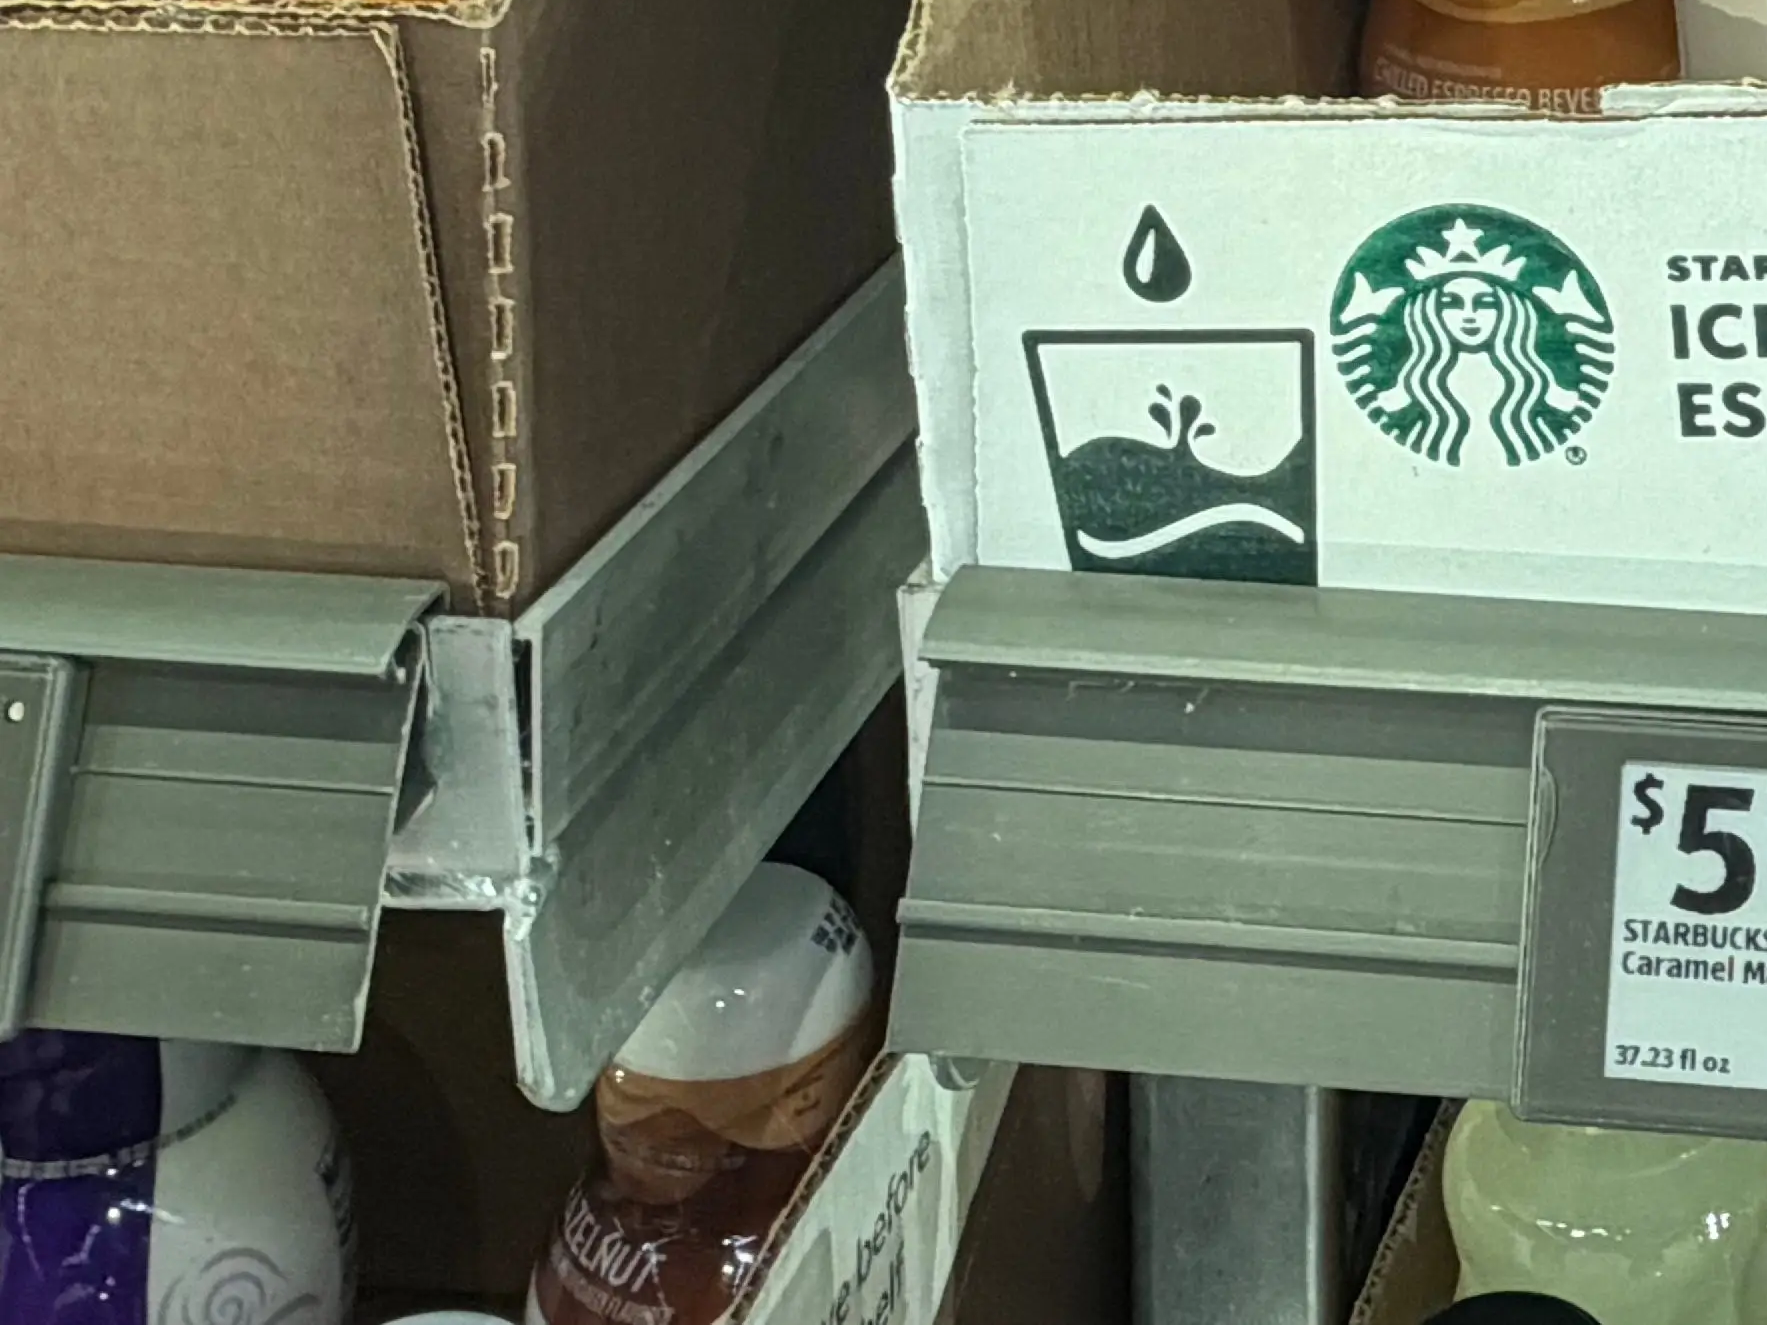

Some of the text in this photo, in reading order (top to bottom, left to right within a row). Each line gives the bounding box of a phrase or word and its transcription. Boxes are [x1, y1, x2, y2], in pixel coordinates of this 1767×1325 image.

[1620, 951, 1736, 983] Caramel
[1614, 1044, 1731, 1075] 37.23 fl oz
[856, 1130, 931, 1287] before
